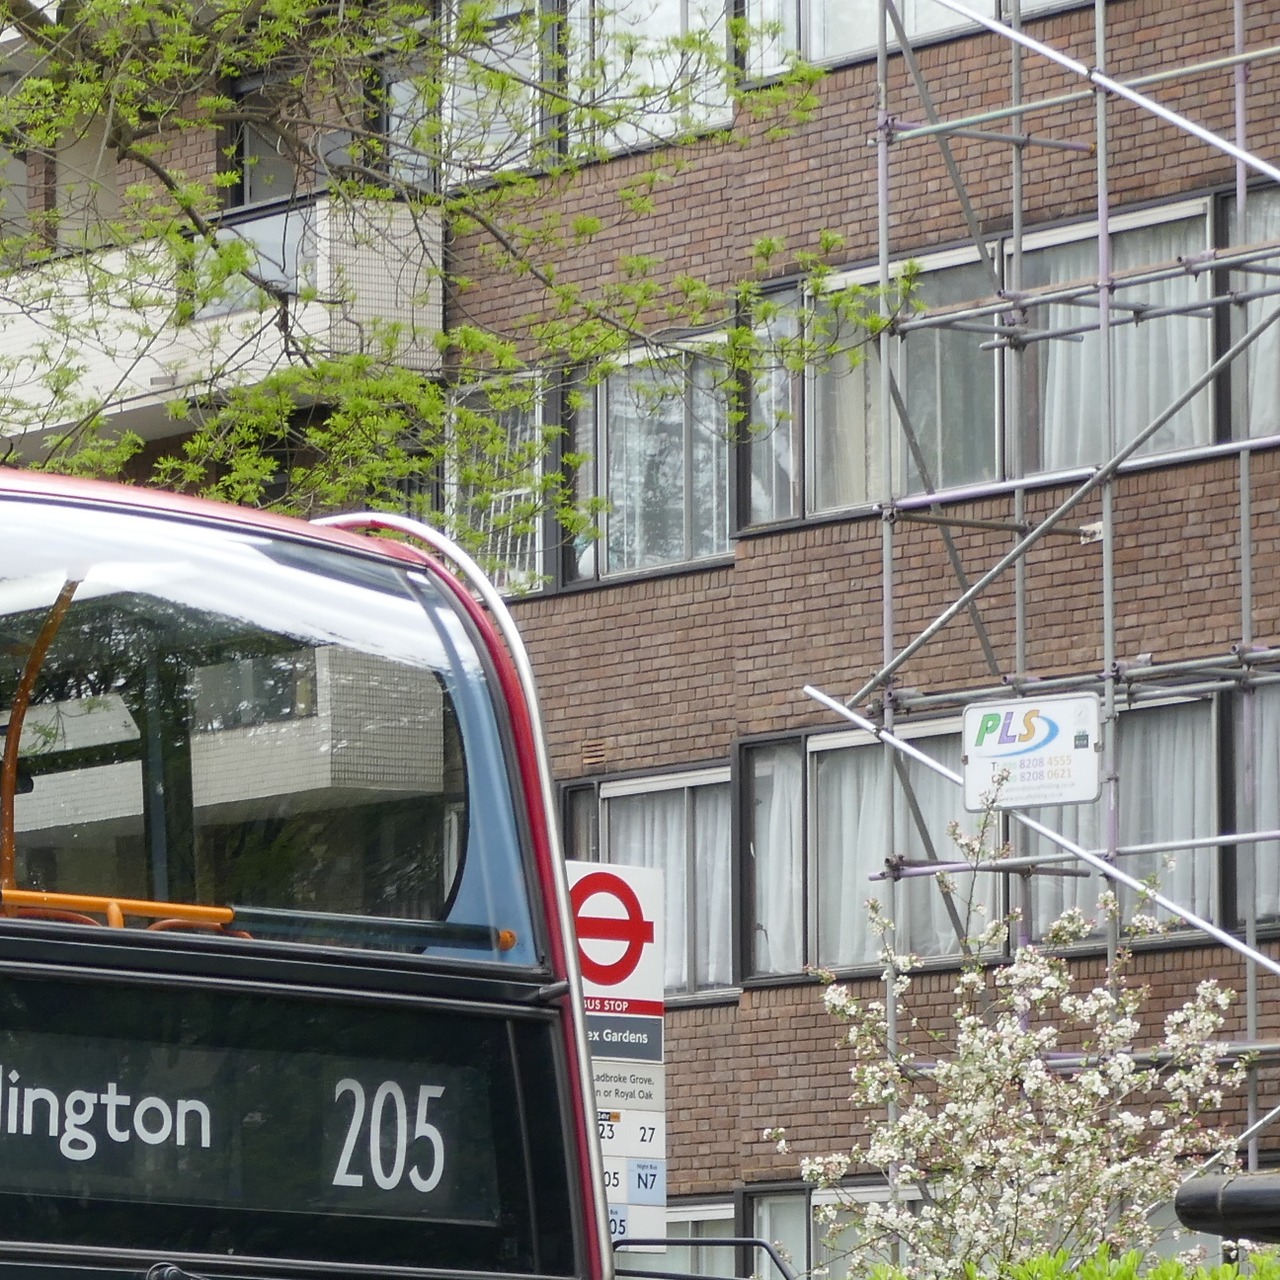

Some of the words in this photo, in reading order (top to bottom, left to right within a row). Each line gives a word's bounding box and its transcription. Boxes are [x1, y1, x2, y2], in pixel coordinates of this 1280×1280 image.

[974, 709, 1040, 747] PLS
[1019, 757, 1045, 769] 8208
[1046, 755, 1072, 767] 4555
[1019, 771, 1045, 782] 8208
[1047, 769, 1072, 780] 0621
[604, 1000, 629, 1011] STOP
[602, 1029, 648, 1044] Gardens
[594, 1072, 627, 1083] adbroke
[614, 1088, 636, 1100] Royal
[638, 1089, 653, 1100] Oak
[332, 1078, 445, 1193] 205
[598, 1123, 615, 1140] 23
[639, 1126, 656, 1143] 27
[637, 1173, 657, 1189] N7
